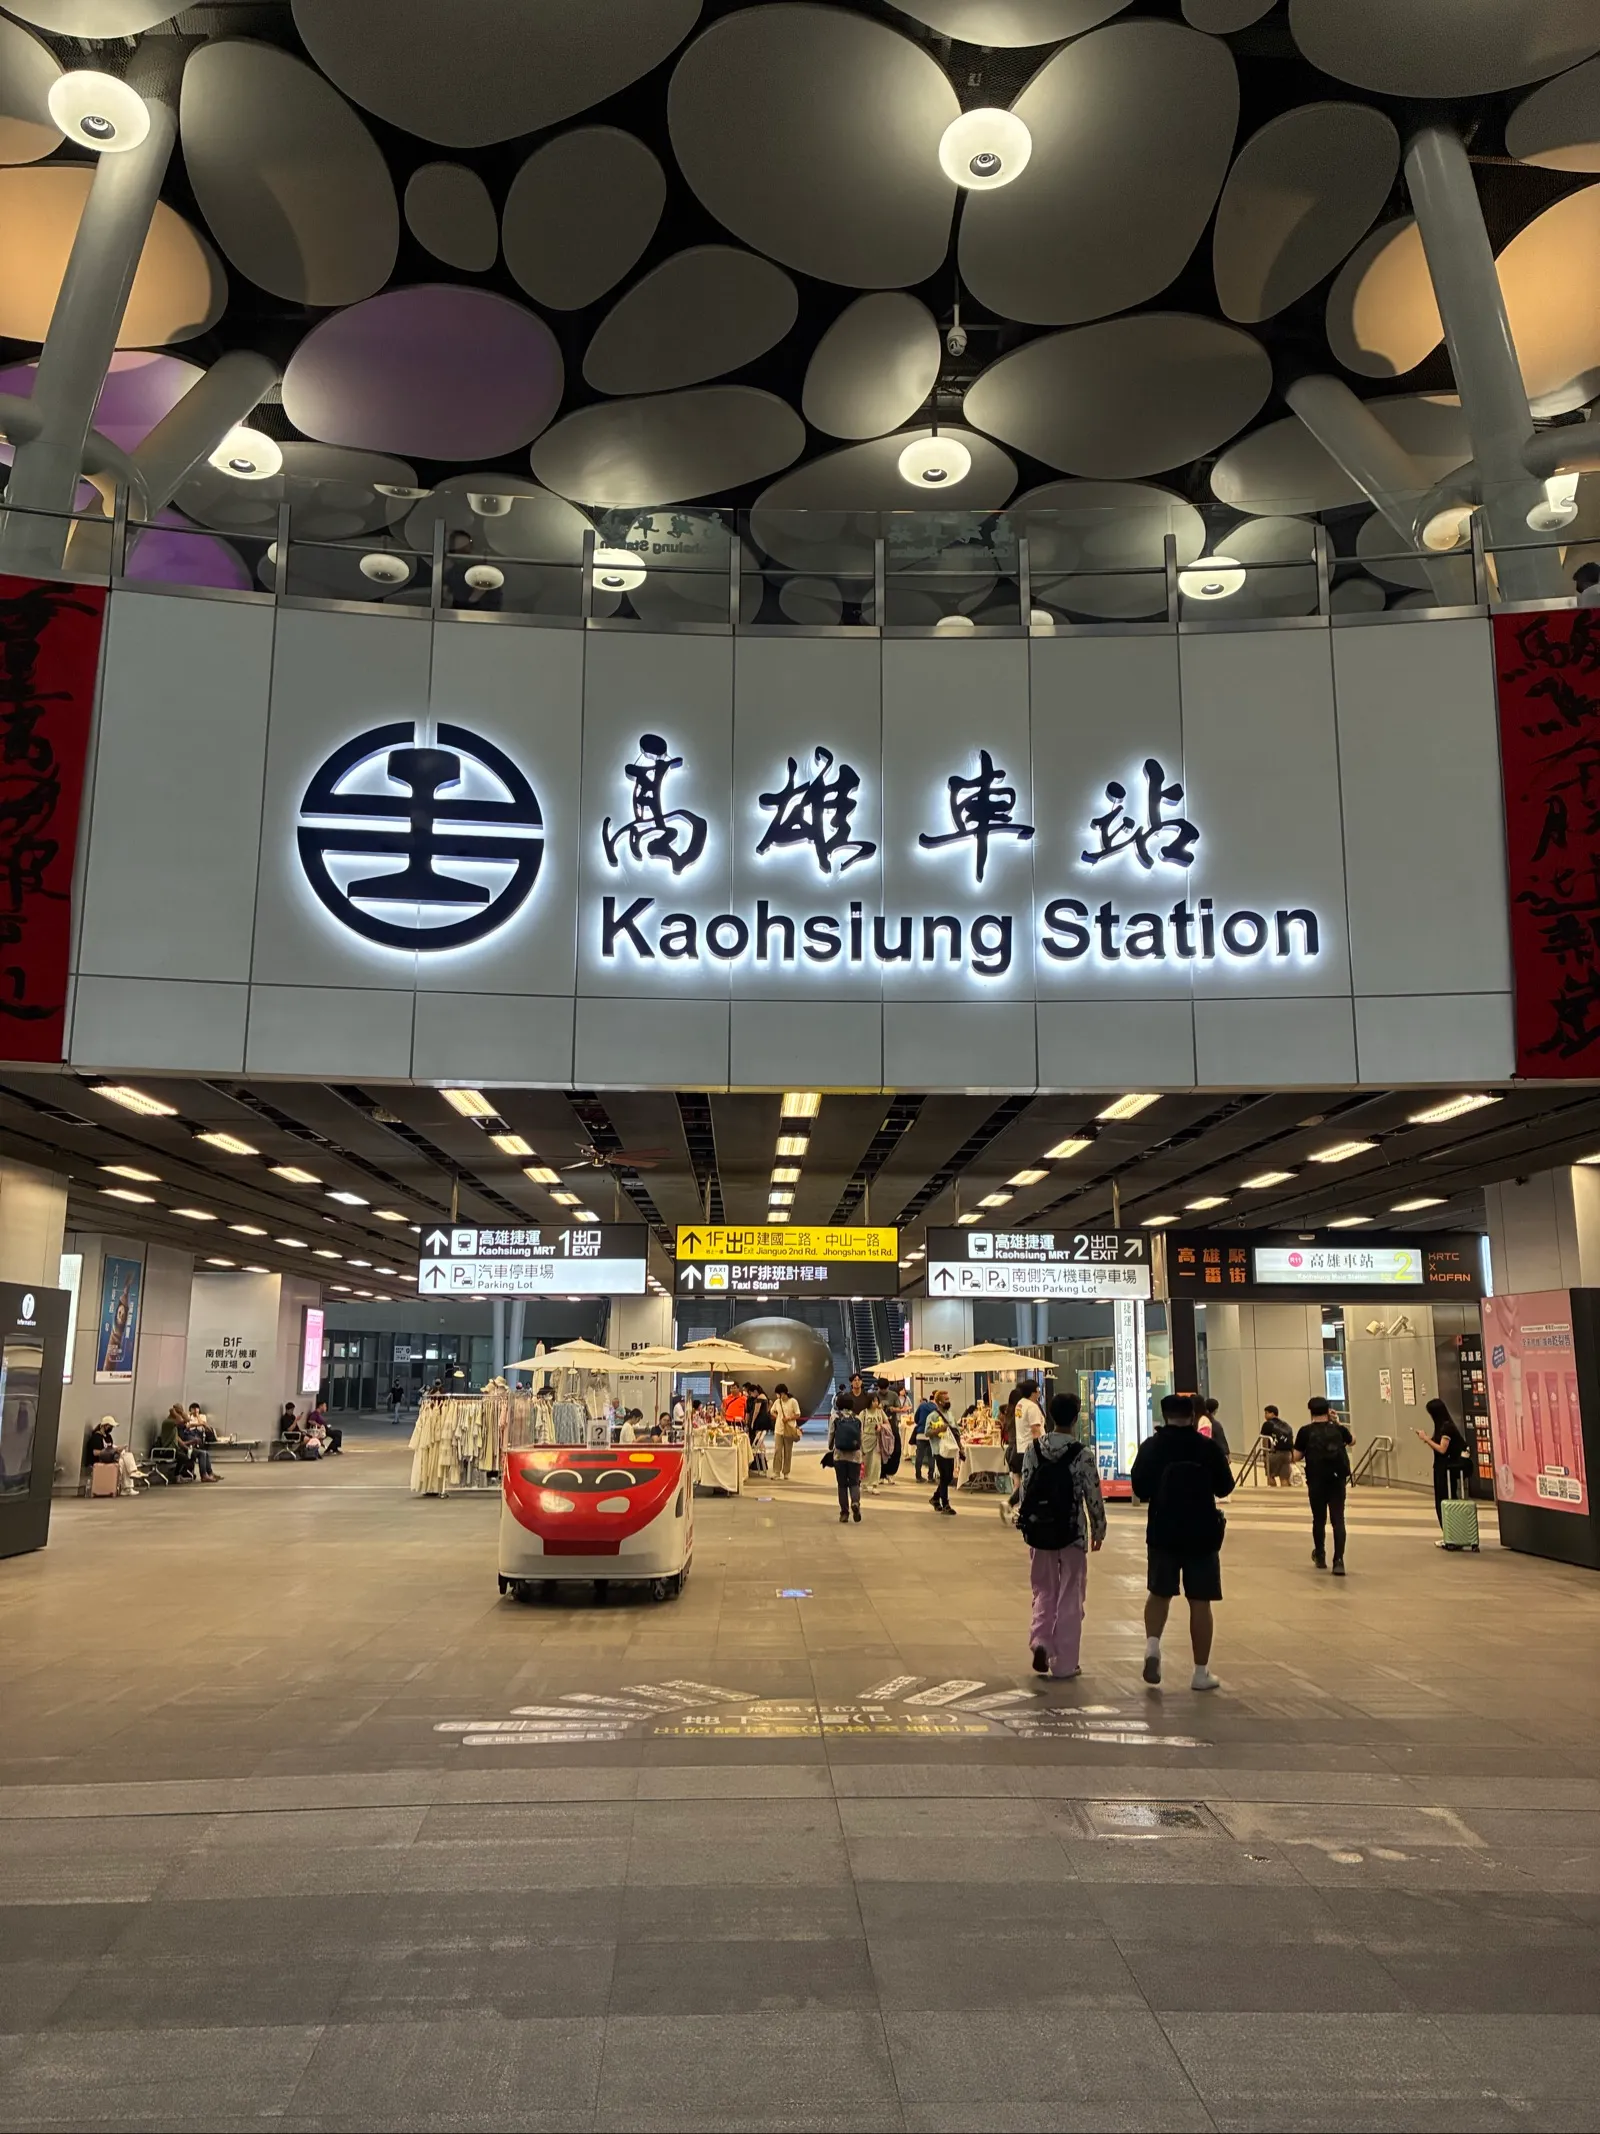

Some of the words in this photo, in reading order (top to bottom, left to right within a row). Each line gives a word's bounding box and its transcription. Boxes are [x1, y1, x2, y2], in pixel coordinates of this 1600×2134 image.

[602, 734, 1200, 883] 高雄車站
[602, 896, 1013, 977] Kaohsiung
[1041, 898, 1320, 961] Station
[479, 1230, 541, 1246] 高雄捷運
[559, 1230, 570, 1256] 1
[572, 1230, 601, 1245] 出口
[756, 1232, 812, 1247] 建國二路
[826, 1233, 880, 1248] 中山一路
[478, 1246, 531, 1257] Kaohsiung
[533, 1246, 556, 1256] MRT
[572, 1246, 601, 1256] EXIT
[756, 1247, 788, 1257] Jianguo
[788, 1247, 804, 1256] 2nd
[804, 1248, 818, 1256] Rd.
[823, 1248, 867, 1258] Jhongshan
[868, 1248, 880, 1257] 1st
[881, 1249, 894, 1257] Rd.
[995, 1233, 1055, 1250] 高雄捷運
[1073, 1234, 1090, 1261] 2
[1090, 1235, 1119, 1249] 出口
[995, 1250, 1047, 1261] Kaohsiung
[1048, 1251, 1071, 1260] MRT
[1091, 1251, 1119, 1261] EXIT
[1428, 1252, 1460, 1261] KRTC
[1310, 1253, 1375, 1269] 高雄車站
[1393, 1251, 1414, 1281] 2
[478, 1264, 555, 1280] 汽車停車場
[731, 1266, 828, 1282] B1F排班計程車
[1012, 1268, 1138, 1285] 南側汽/機車停車場
[1179, 1267, 1247, 1284] 一番街
[1430, 1273, 1471, 1282] MOFAN
[478, 1280, 515, 1291] Parking
[517, 1280, 534, 1290] Lot
[731, 1280, 752, 1290] Taxi
[752, 1280, 780, 1291] Stand
[1012, 1284, 1041, 1293] South
[1042, 1285, 1079, 1295] Parking
[1081, 1285, 1098, 1294] Lot
[223, 1336, 243, 1347] B1F
[205, 1348, 257, 1359] 南側汽/機車
[933, 1344, 953, 1352] B1F
[211, 1360, 238, 1369] 停車場
